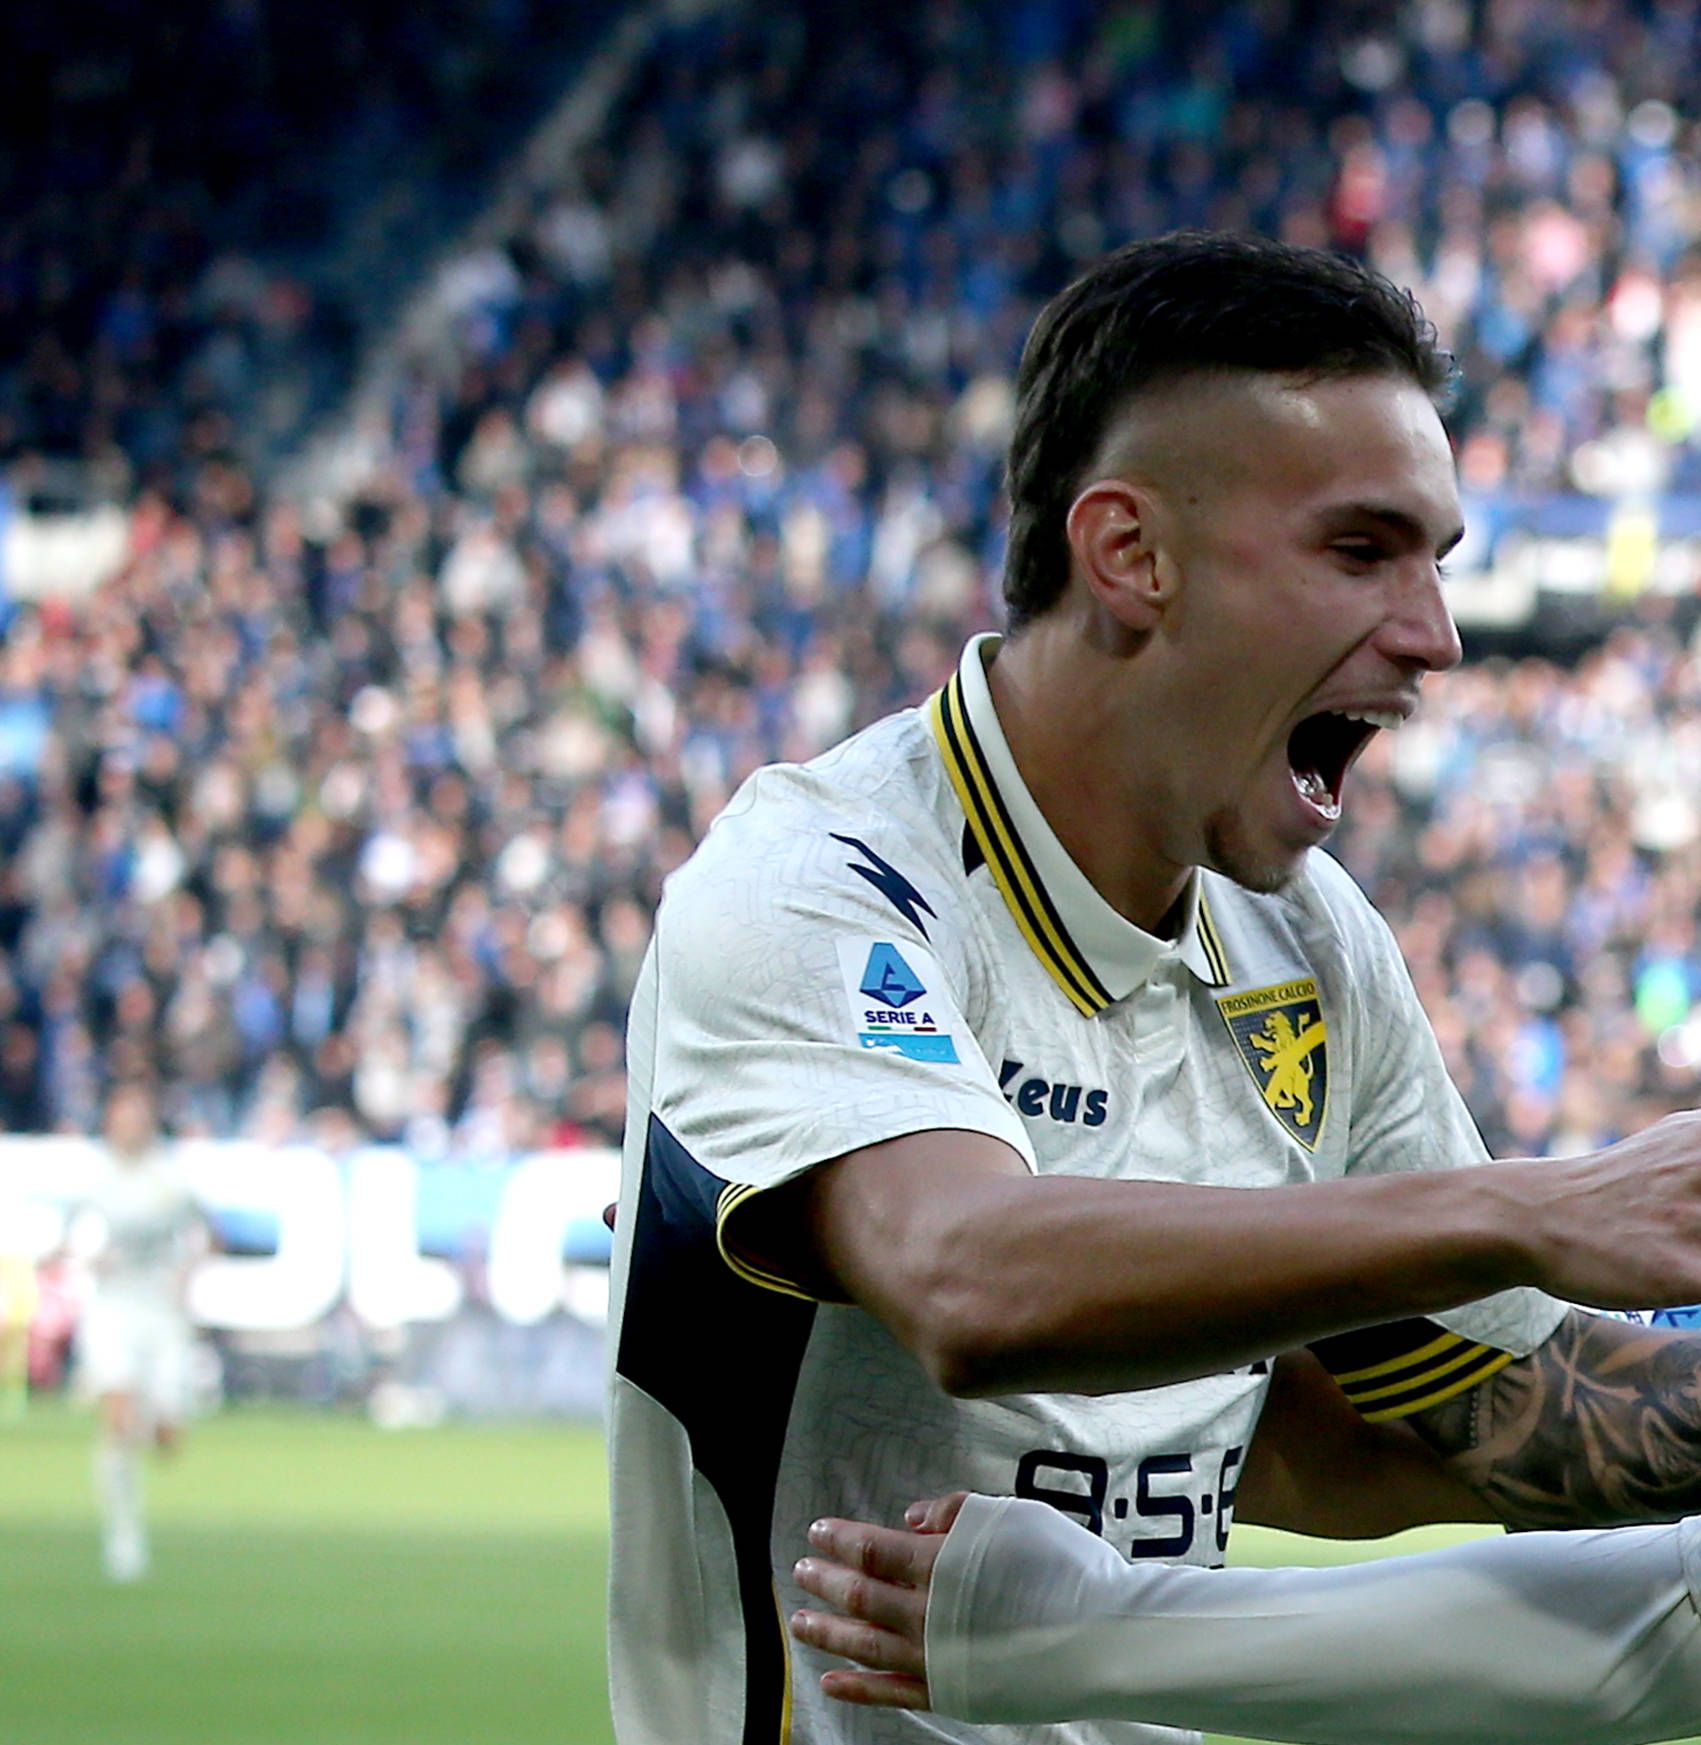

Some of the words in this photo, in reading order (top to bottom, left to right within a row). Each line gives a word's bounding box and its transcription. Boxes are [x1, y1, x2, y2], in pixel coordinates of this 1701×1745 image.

[1222, 989, 1278, 1015] FROSINONE
[1279, 982, 1315, 1001] CALCIO
[864, 1010, 917, 1025] SERIE
[922, 1012, 935, 1025] A
